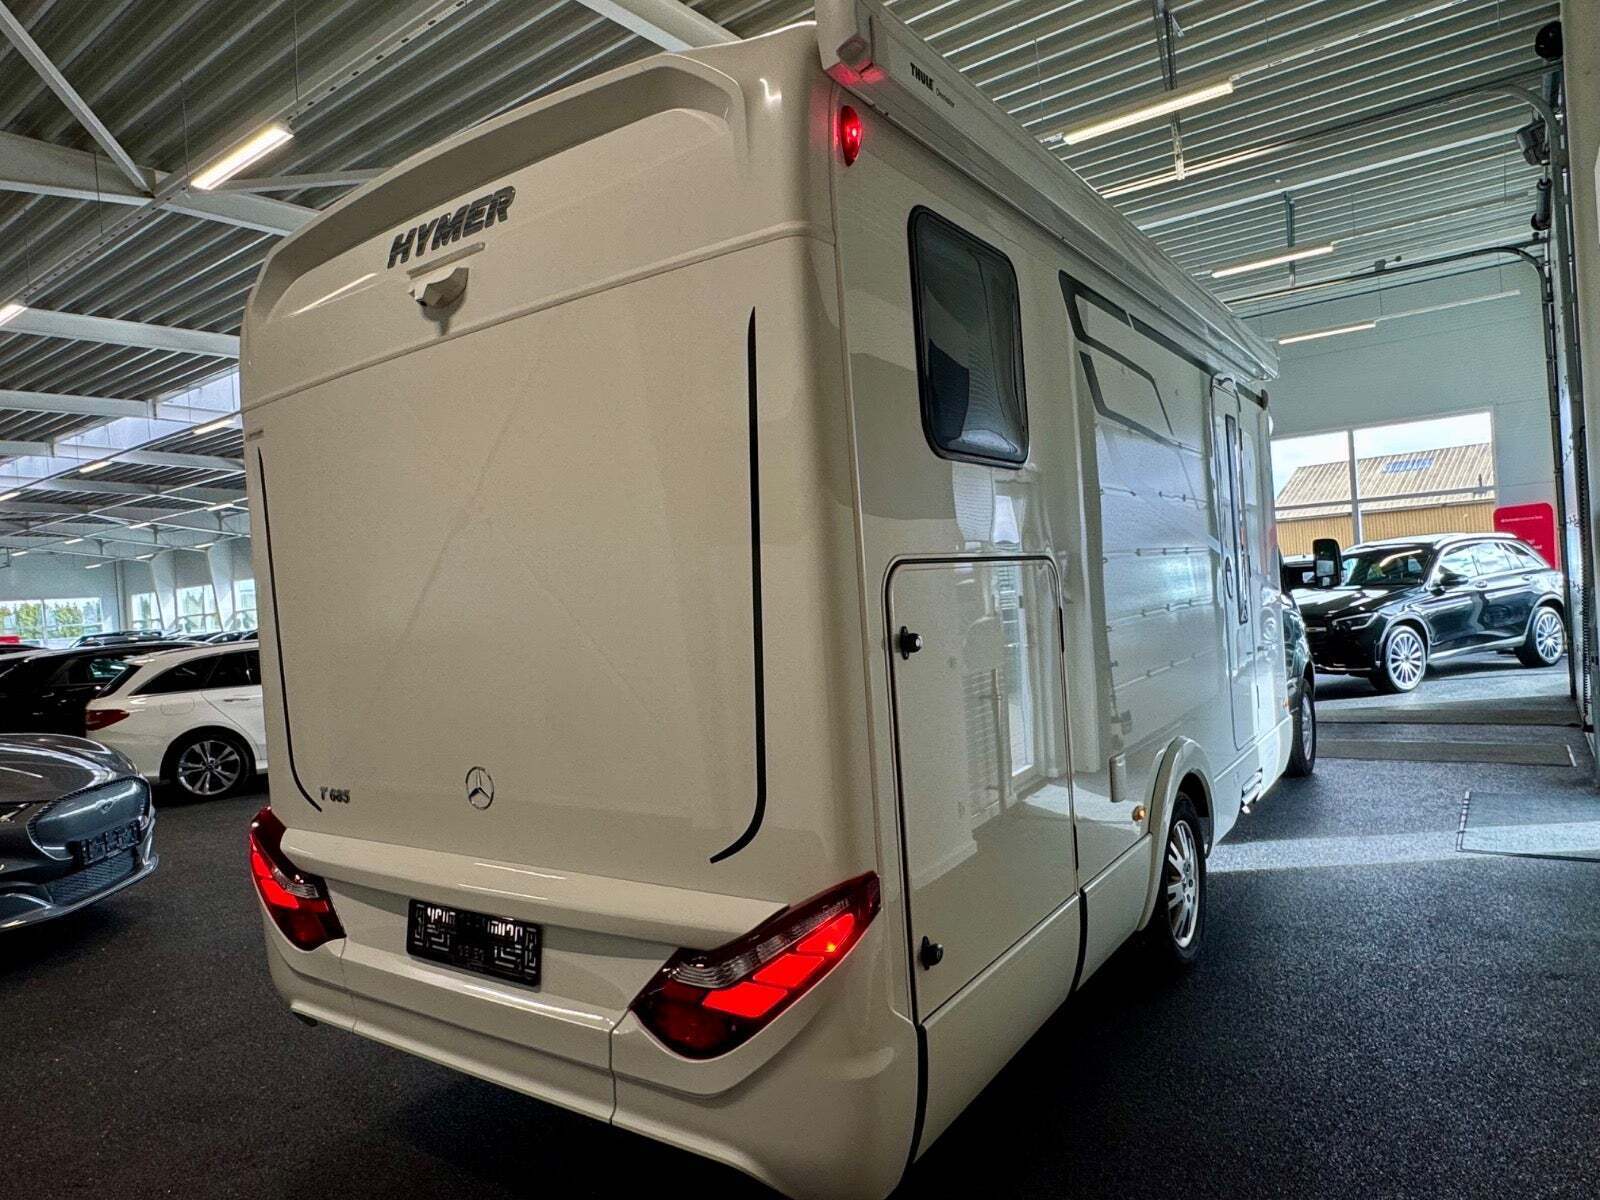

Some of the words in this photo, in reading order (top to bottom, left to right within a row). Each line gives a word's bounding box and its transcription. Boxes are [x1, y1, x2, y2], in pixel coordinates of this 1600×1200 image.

[910, 62, 933, 91] THULE
[387, 185, 516, 269] HYMER
[320, 786, 328, 801] T
